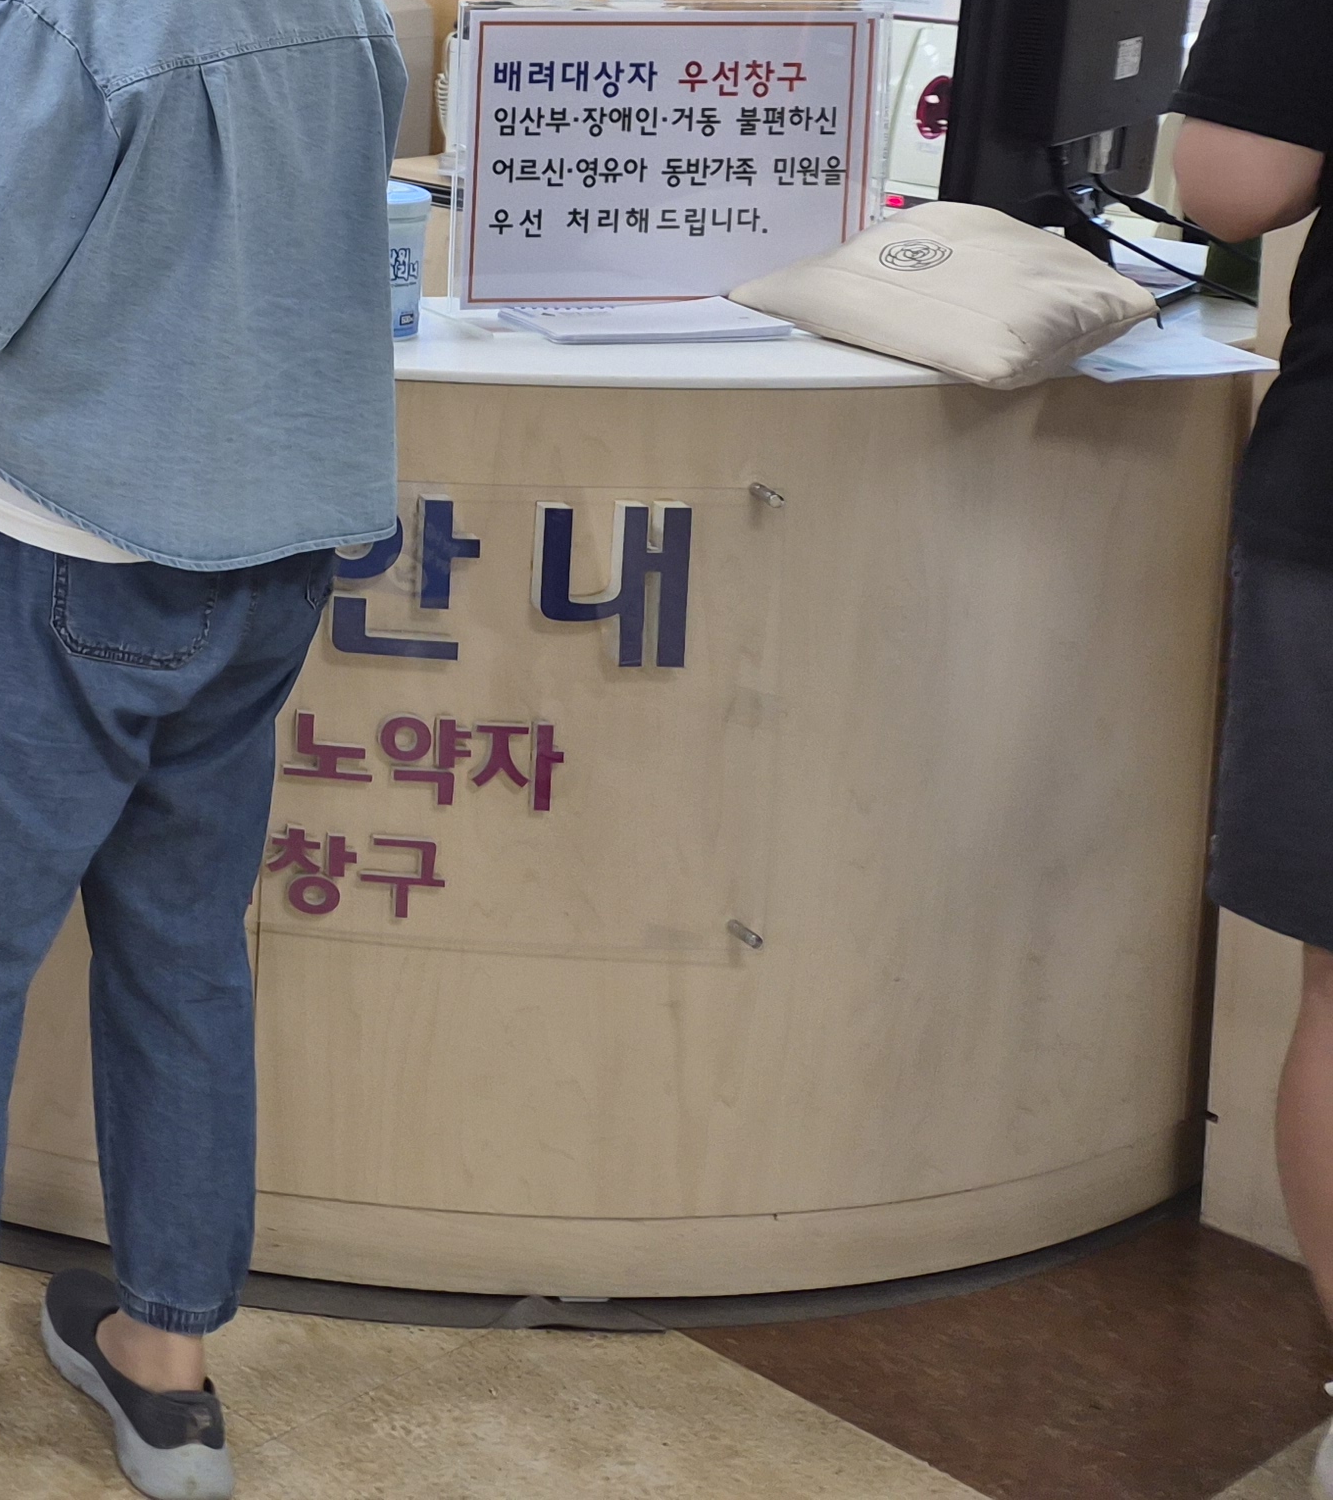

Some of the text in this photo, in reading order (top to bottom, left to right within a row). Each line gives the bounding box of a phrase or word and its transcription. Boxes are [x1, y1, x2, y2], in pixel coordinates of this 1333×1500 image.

[493, 60, 808, 98] 배려대상자 우선창구
[494, 106, 838, 137] 임산부·장애인·거동 불편하신
[491, 156, 847, 187] 어르신·영유아 동반가족 민원을
[489, 208, 544, 238] 우선
[283, 708, 565, 811] 노약자
[265, 823, 446, 919] 창구
